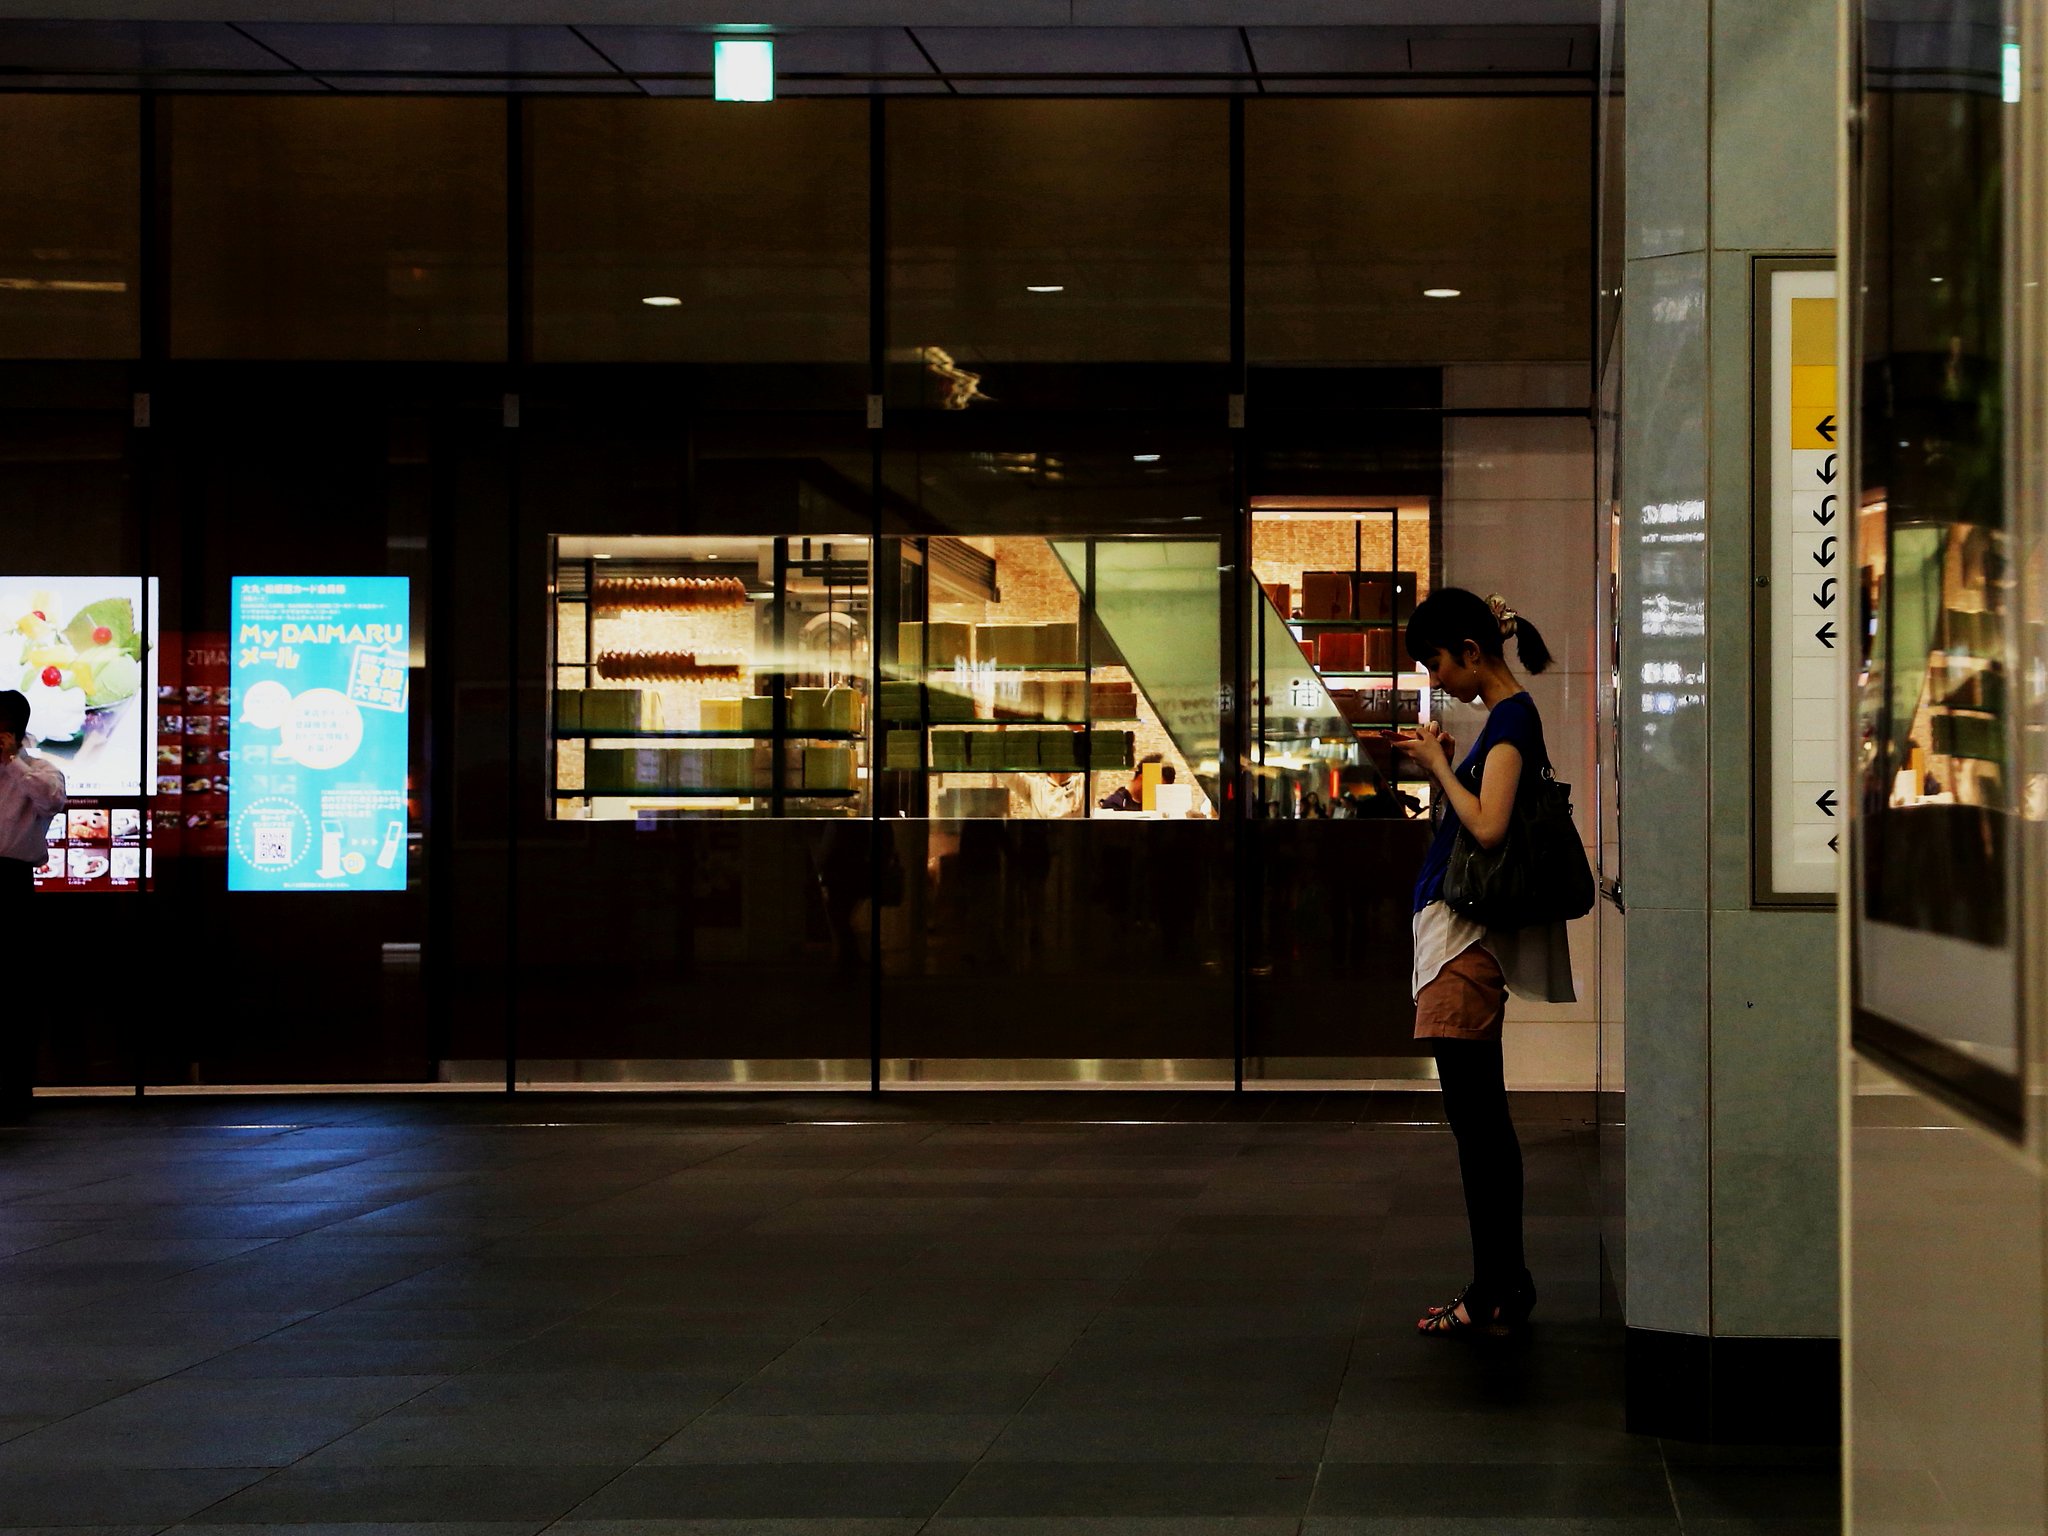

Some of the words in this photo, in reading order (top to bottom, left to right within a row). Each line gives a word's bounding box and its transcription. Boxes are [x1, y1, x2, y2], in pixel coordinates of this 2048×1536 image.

[239, 623, 279, 648] My
[281, 623, 403, 644] DAIMARU
[238, 646, 300, 669] メール
